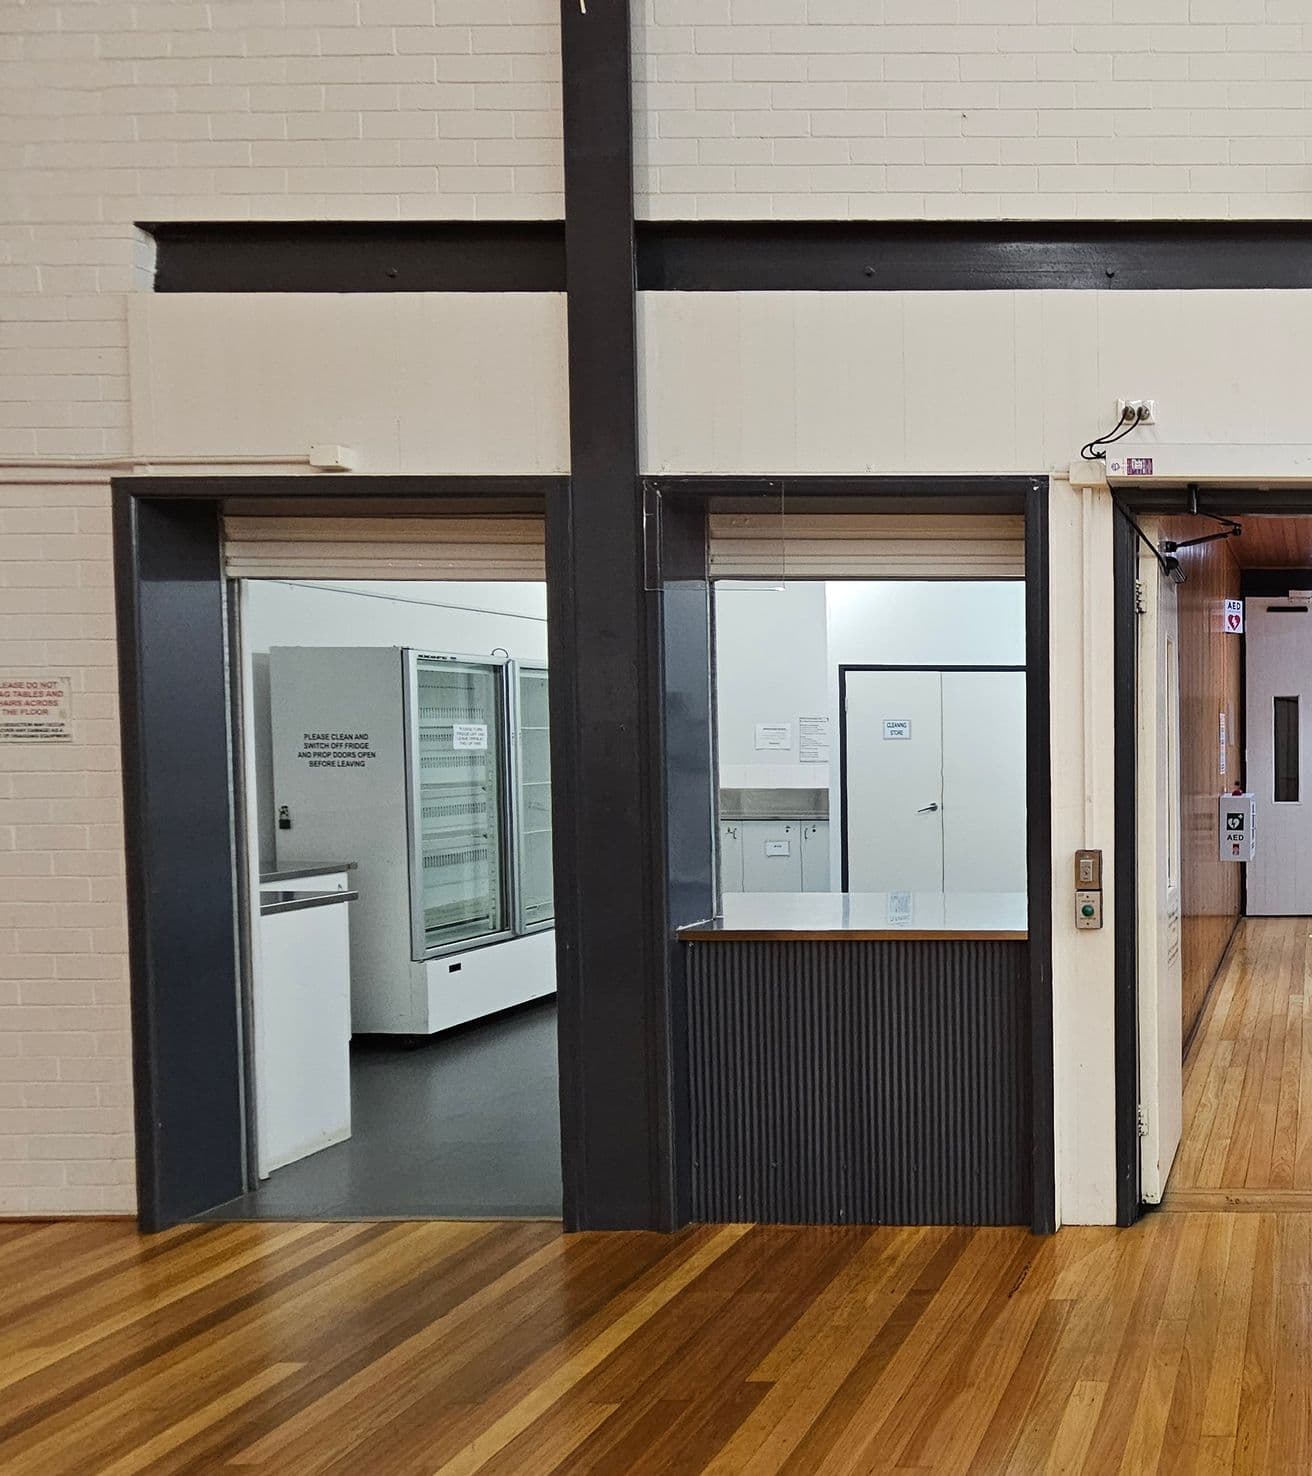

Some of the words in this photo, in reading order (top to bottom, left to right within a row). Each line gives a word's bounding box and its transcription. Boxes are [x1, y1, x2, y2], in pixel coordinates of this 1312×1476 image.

[1227, 601, 1241, 610] AED
[0, 681, 24, 689] EASE
[26, 681, 38, 689] DO
[40, 681, 58, 689] NOT
[303, 733, 330, 741] PLEASE
[331, 733, 354, 741] CLEAN
[354, 733, 369, 741] AND
